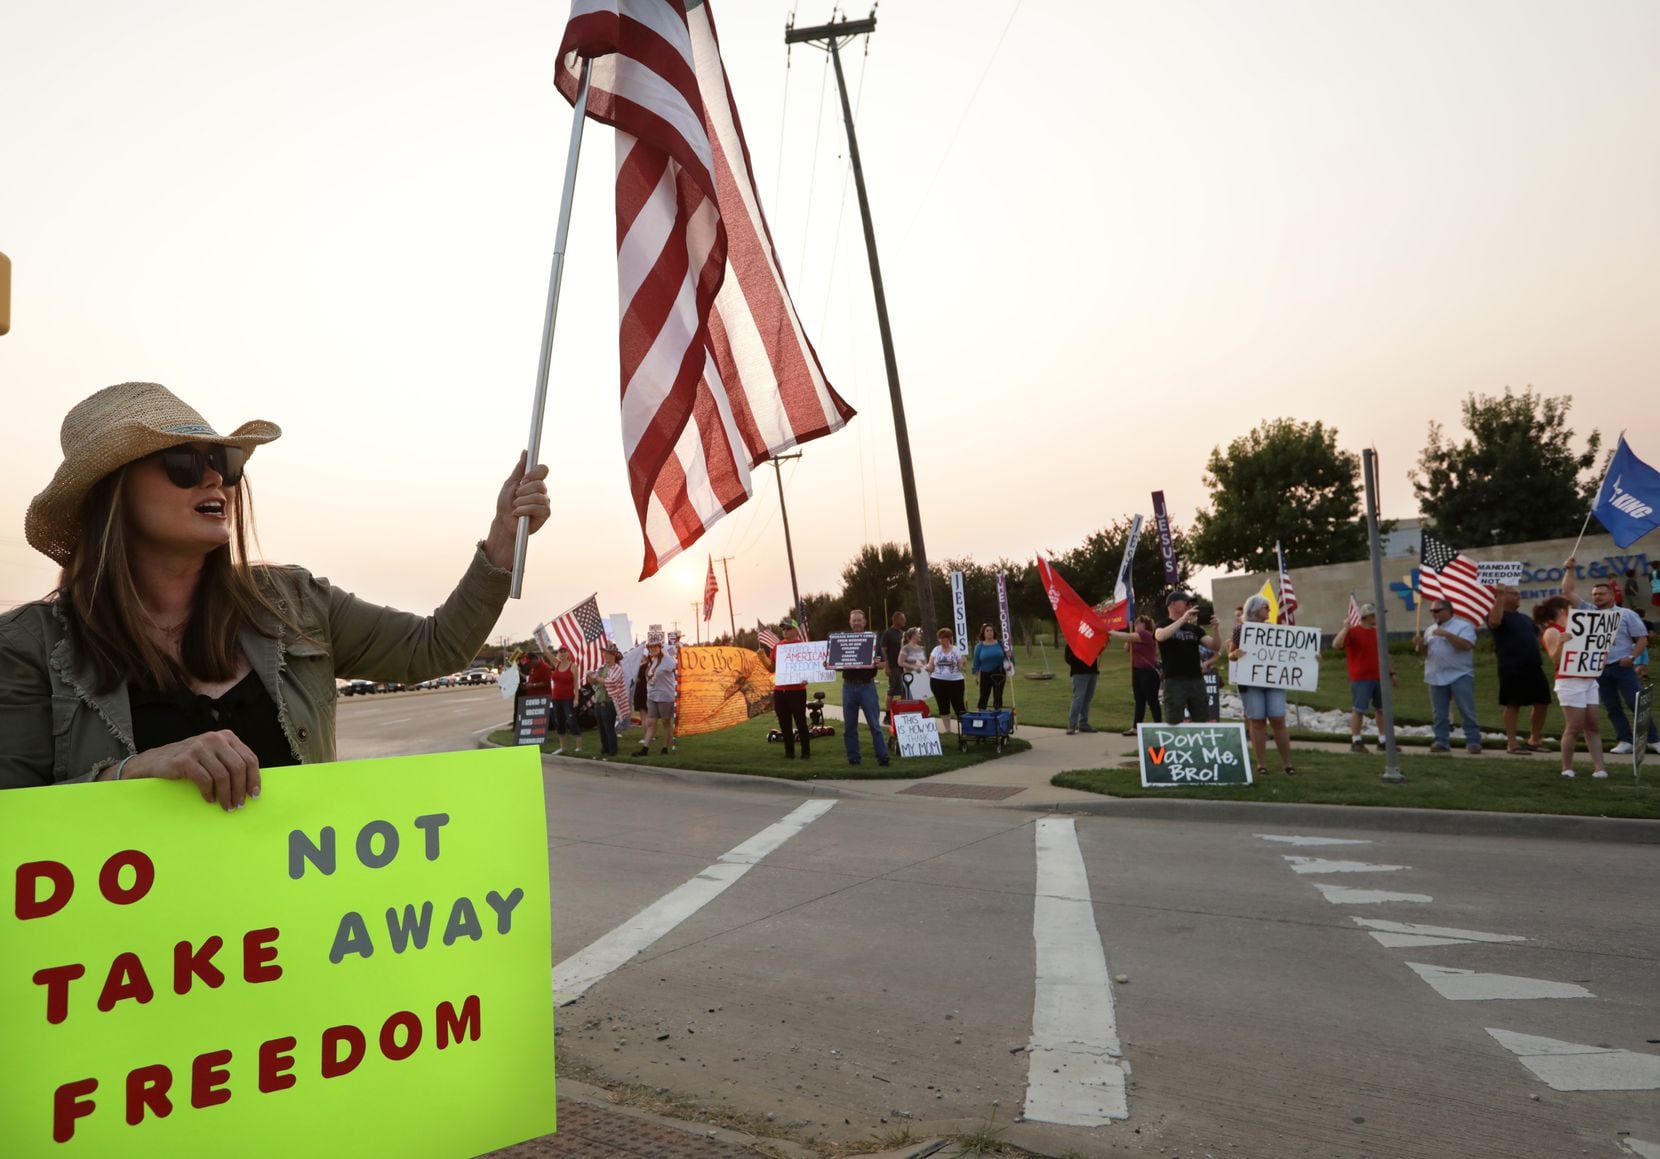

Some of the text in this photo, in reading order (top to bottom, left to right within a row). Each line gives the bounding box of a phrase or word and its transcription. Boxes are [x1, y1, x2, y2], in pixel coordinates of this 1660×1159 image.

[1156, 502, 1174, 573] JESUS
[1520, 562, 1585, 584] Scot
[955, 574, 966, 651] JESUS
[1571, 612, 1620, 636] STAND
[1243, 627, 1317, 652] FREEDOM
[1585, 633, 1612, 651] FOR
[680, 650, 707, 670] We
[785, 651, 829, 662] AMERICAN
[1251, 665, 1303, 686] FEAR
[898, 725, 906, 734] IS
[909, 724, 924, 734] HOW
[901, 715, 919, 725] THIS
[901, 741, 942, 756] MY MOM
[1155, 729, 1224, 747] Don't
[1148, 745, 1238, 766] Vax Me,
[15, 813, 450, 920] DO NOT
[32, 888, 524, 1025] TAKE AWAY
[53, 995, 481, 1143] FREEDOM
